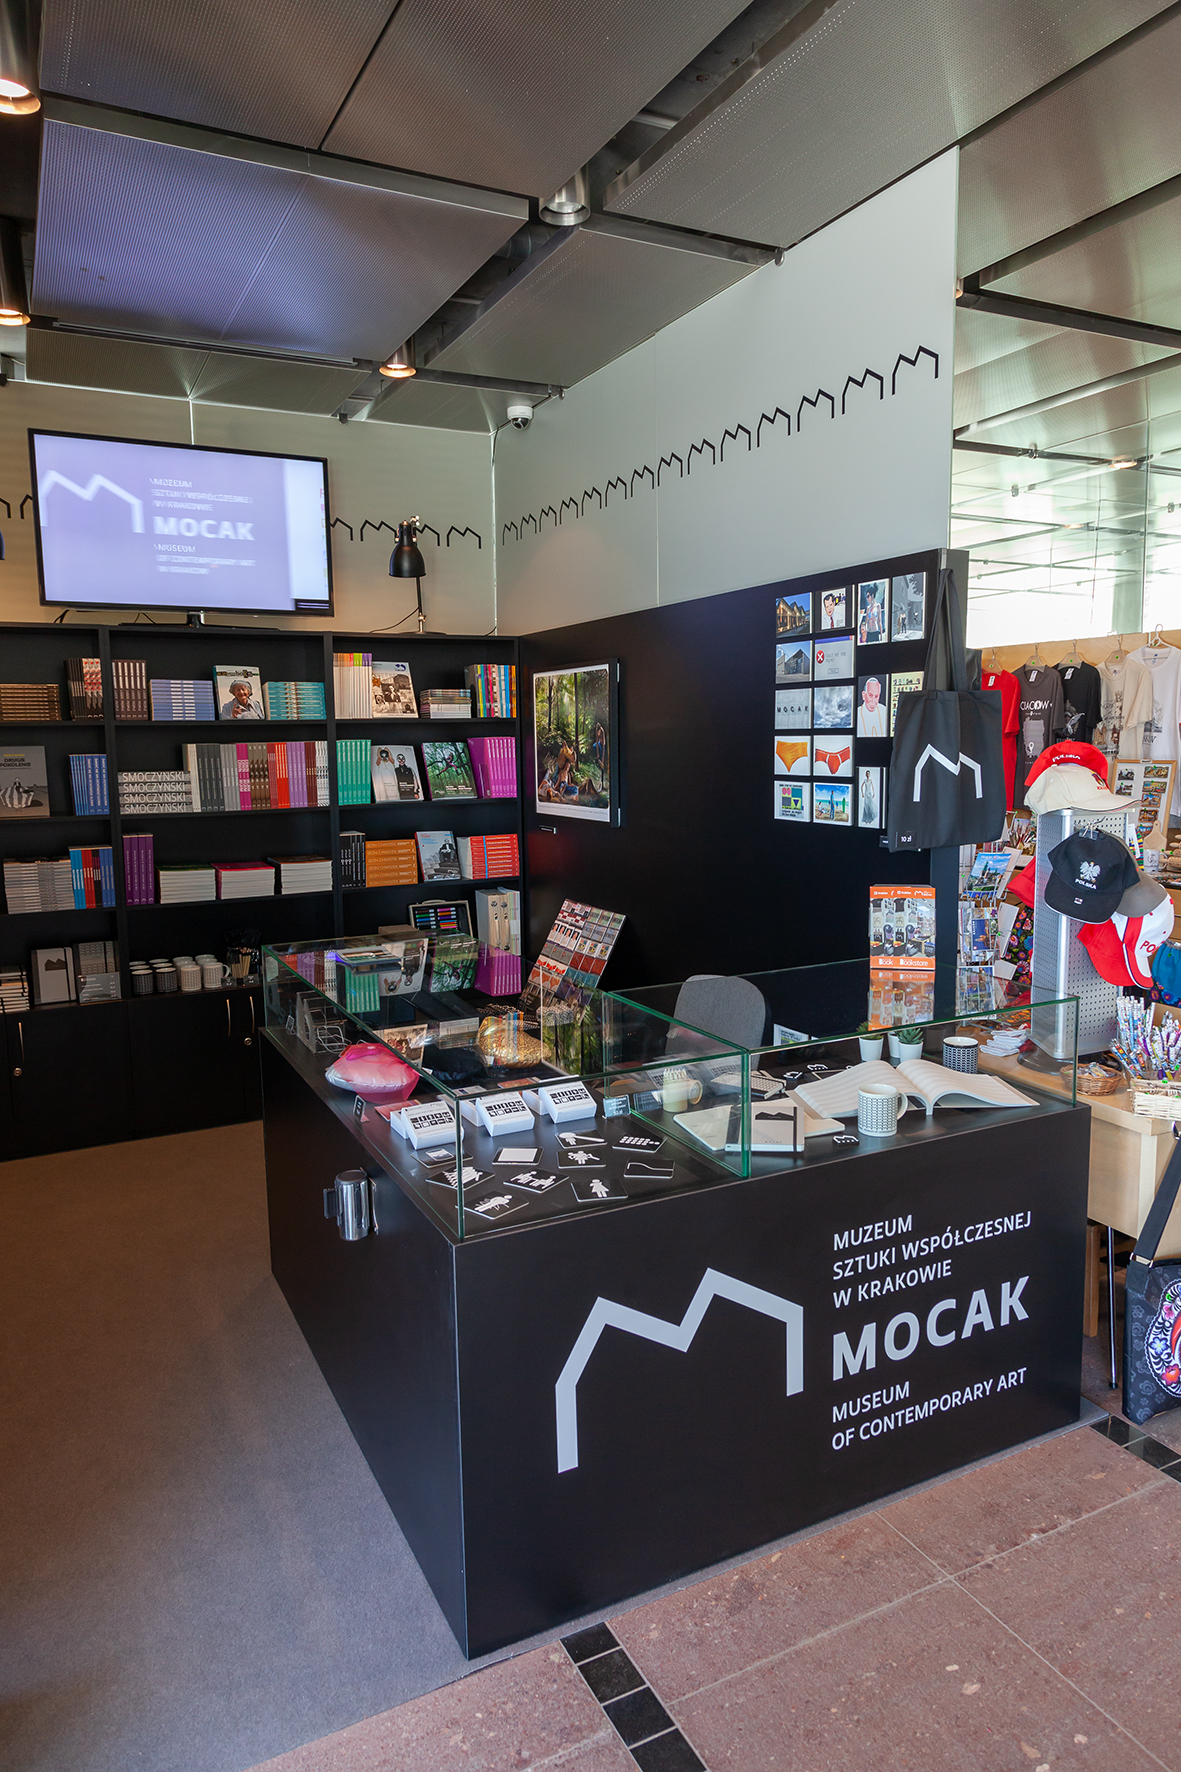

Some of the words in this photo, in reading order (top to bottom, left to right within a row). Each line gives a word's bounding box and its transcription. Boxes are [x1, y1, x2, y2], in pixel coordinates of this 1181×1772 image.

[153, 516, 256, 540] MOCAK
[1075, 878, 1096, 889] POLSKA
[832, 1247, 896, 1280] SZTUKI
[902, 1210, 1032, 1260] WSPÓŁCZESNEJ
[834, 1214, 912, 1250] MUZEUM
[833, 1288, 852, 1308] W
[858, 1259, 952, 1302] KRAKOWIE
[832, 1276, 1030, 1381] MOCAK
[832, 1381, 910, 1422] MUSEUM
[832, 1428, 855, 1450] OF
[859, 1378, 994, 1440] CONTEMPORARY
[996, 1367, 1027, 1392] ART
